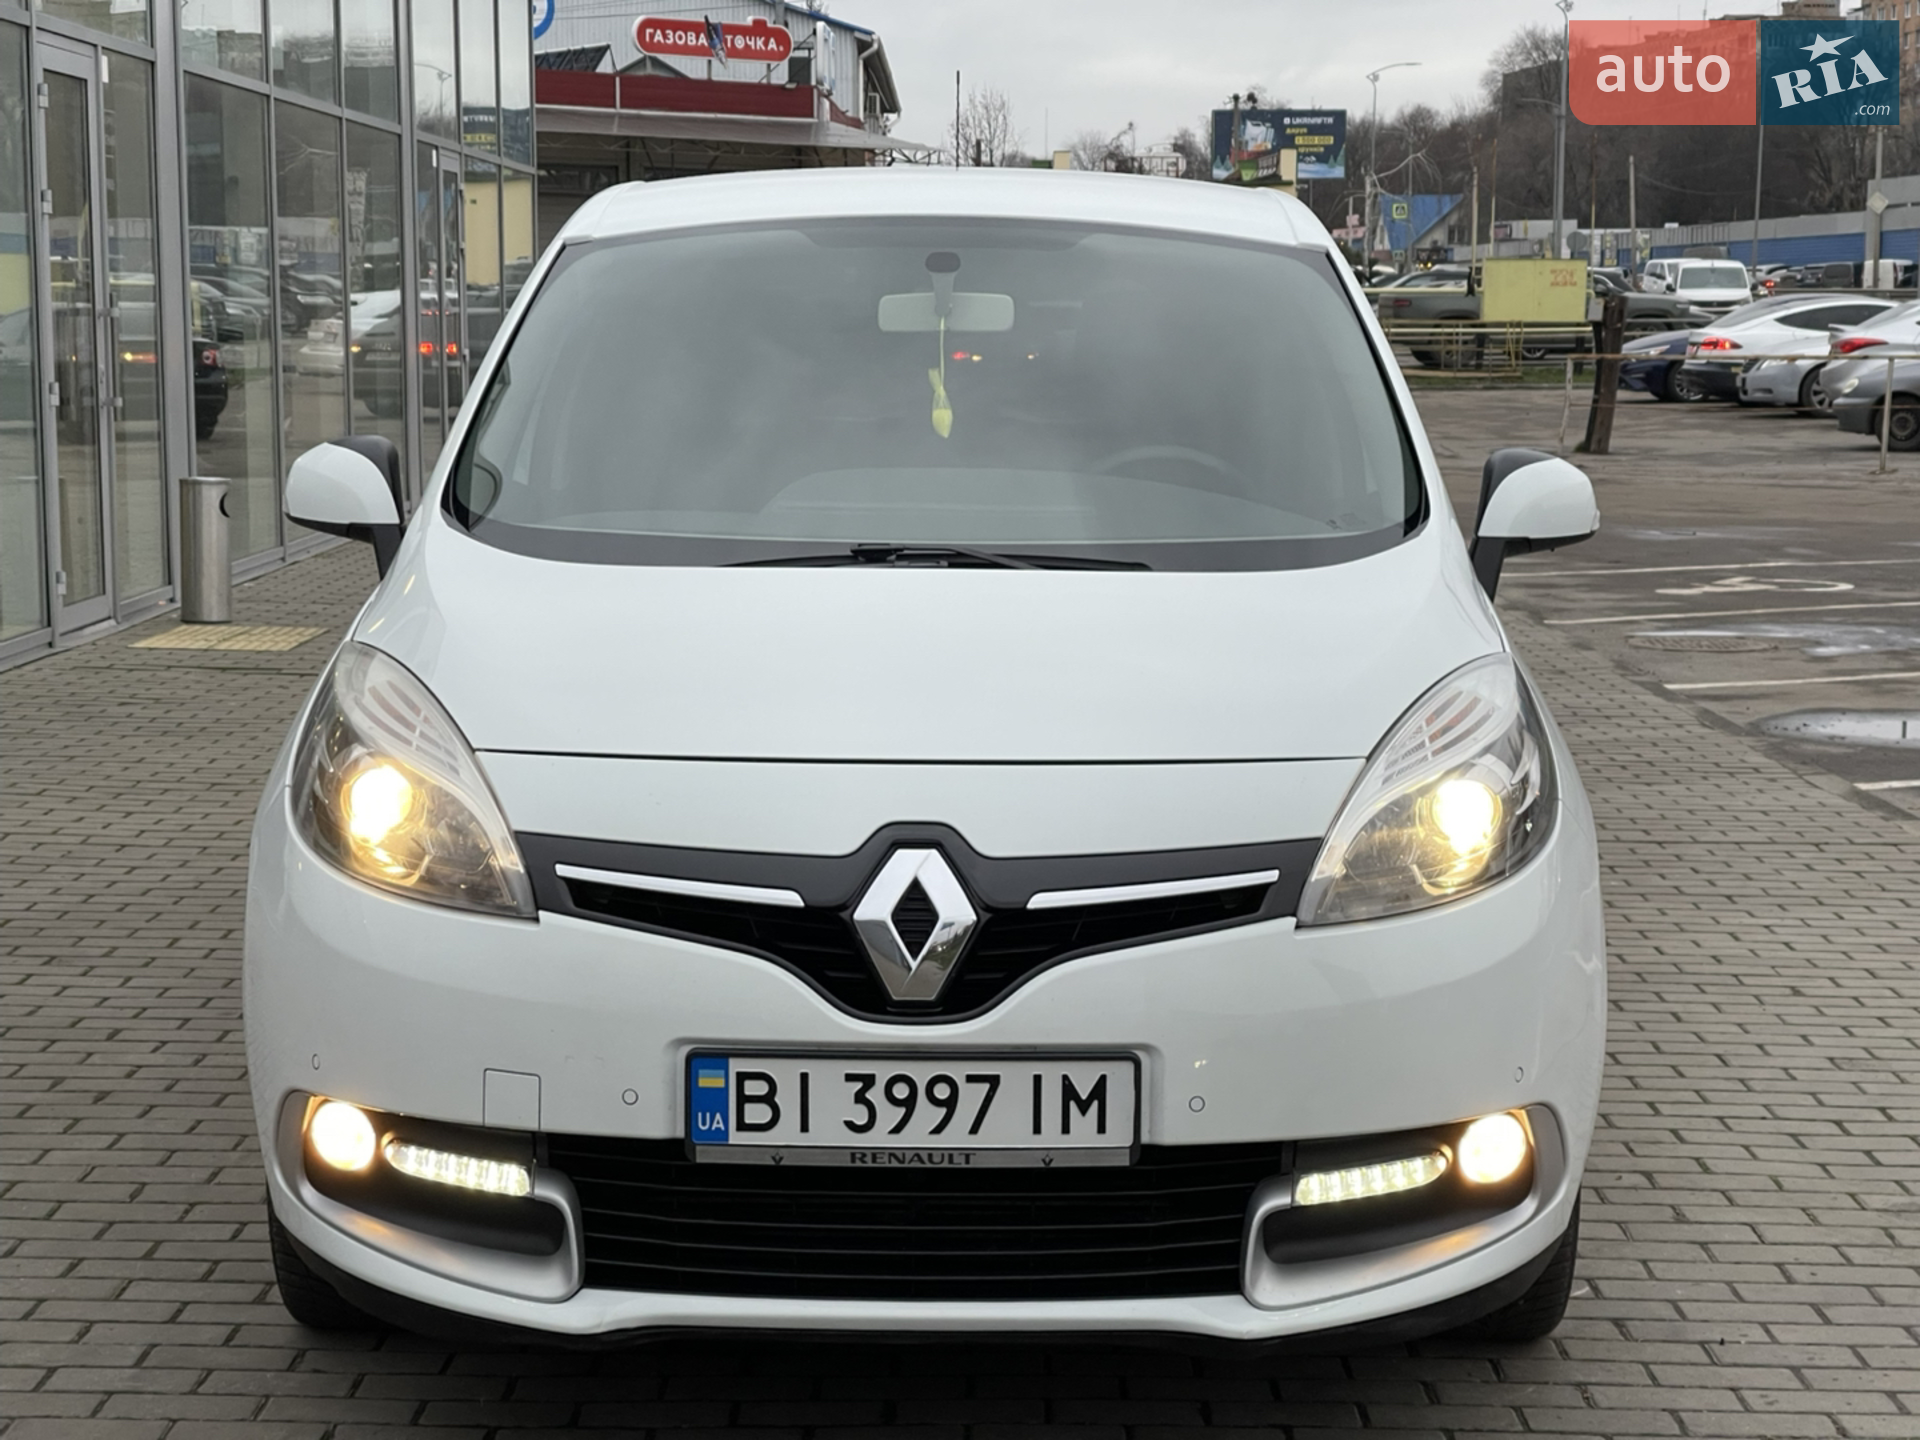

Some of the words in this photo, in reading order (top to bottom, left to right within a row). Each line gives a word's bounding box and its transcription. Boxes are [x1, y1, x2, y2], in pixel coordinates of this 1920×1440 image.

[645, 28, 708, 46] ГАЗОВА
[735, 1070, 810, 1133] BI
[843, 1072, 1001, 1135] 3997
[1032, 1073, 1108, 1136] IM
[697, 1112, 726, 1132] UA
[849, 1151, 977, 1166] RENAULT
